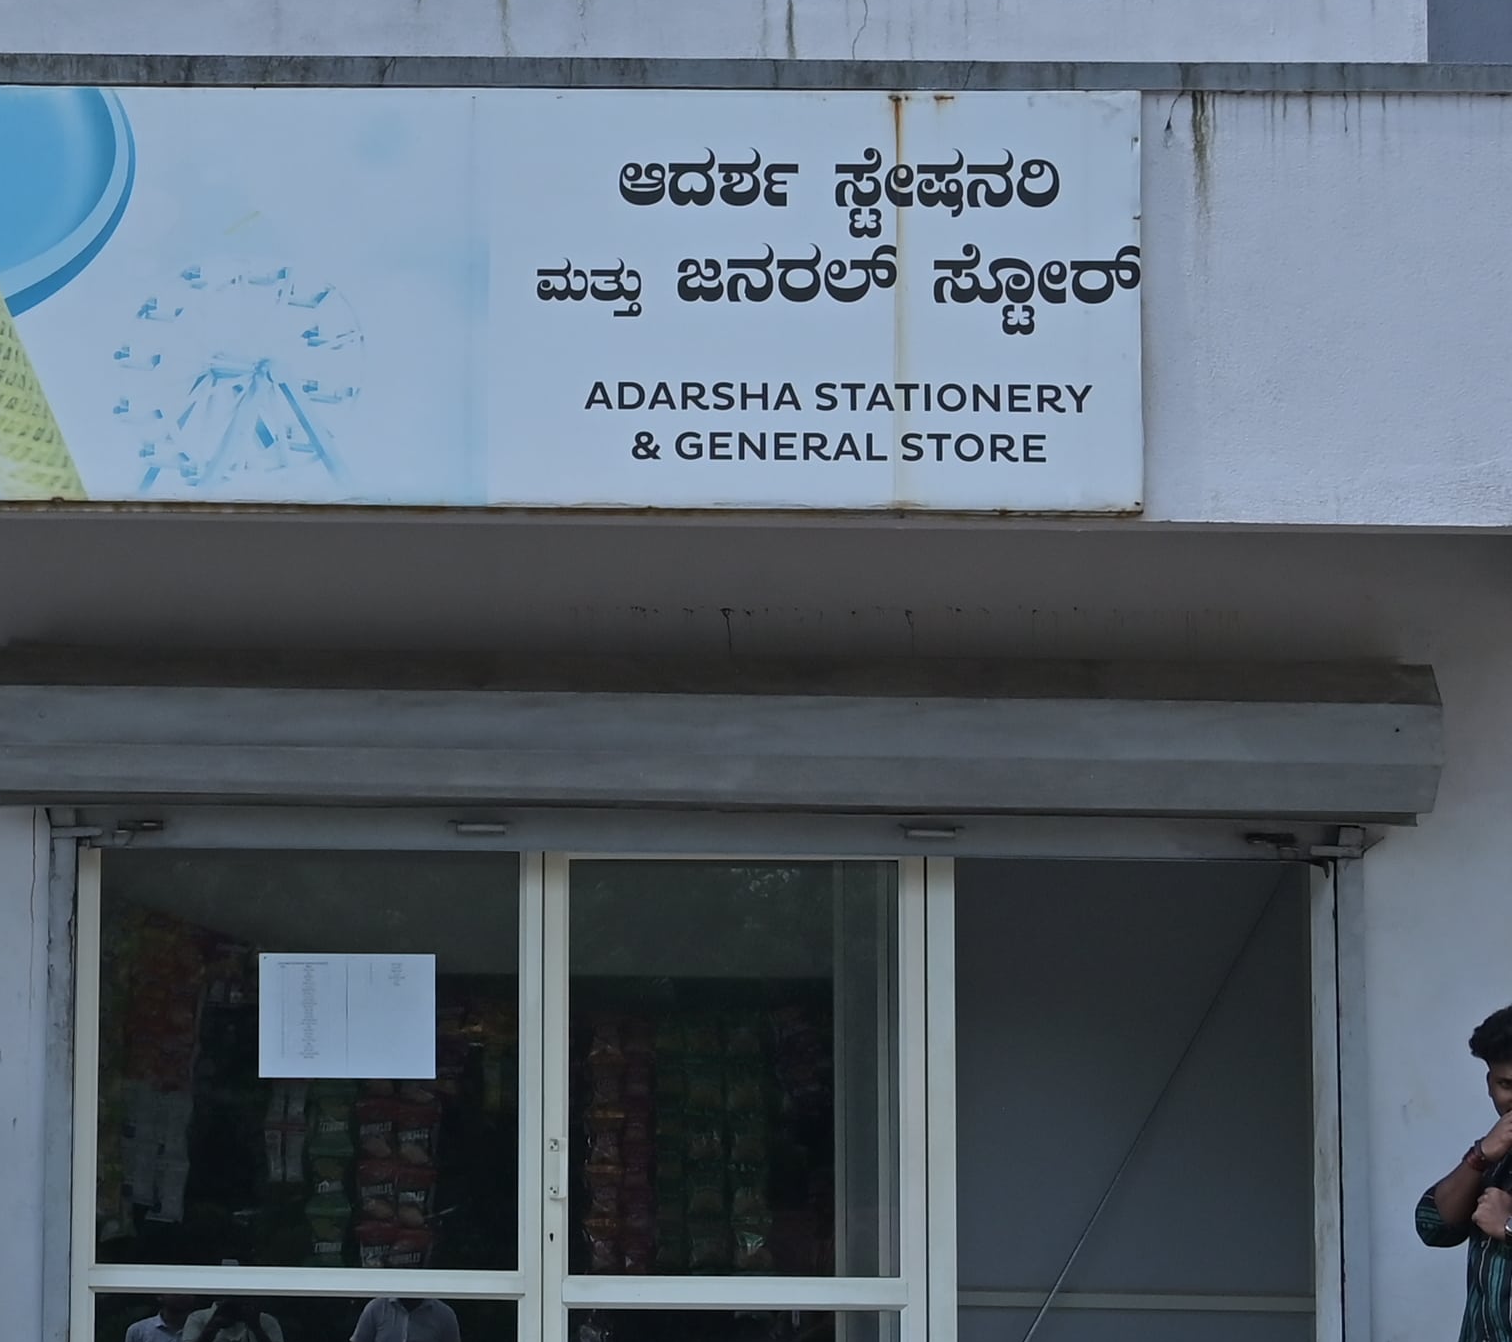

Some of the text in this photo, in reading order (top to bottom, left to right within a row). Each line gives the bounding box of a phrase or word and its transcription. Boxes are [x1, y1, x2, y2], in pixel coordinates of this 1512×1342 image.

[619, 147, 1060, 238] ಆದರ್ಶ ಸ್ಟೇಷನರಿ
[536, 244, 1141, 335] ಮತ್ತು ಜನರಲ್ ಸ್ಟೋರ್
[584, 381, 1092, 414] ADARSHA STATIONERY
[631, 431, 1047, 463] & GENERAL STORE
